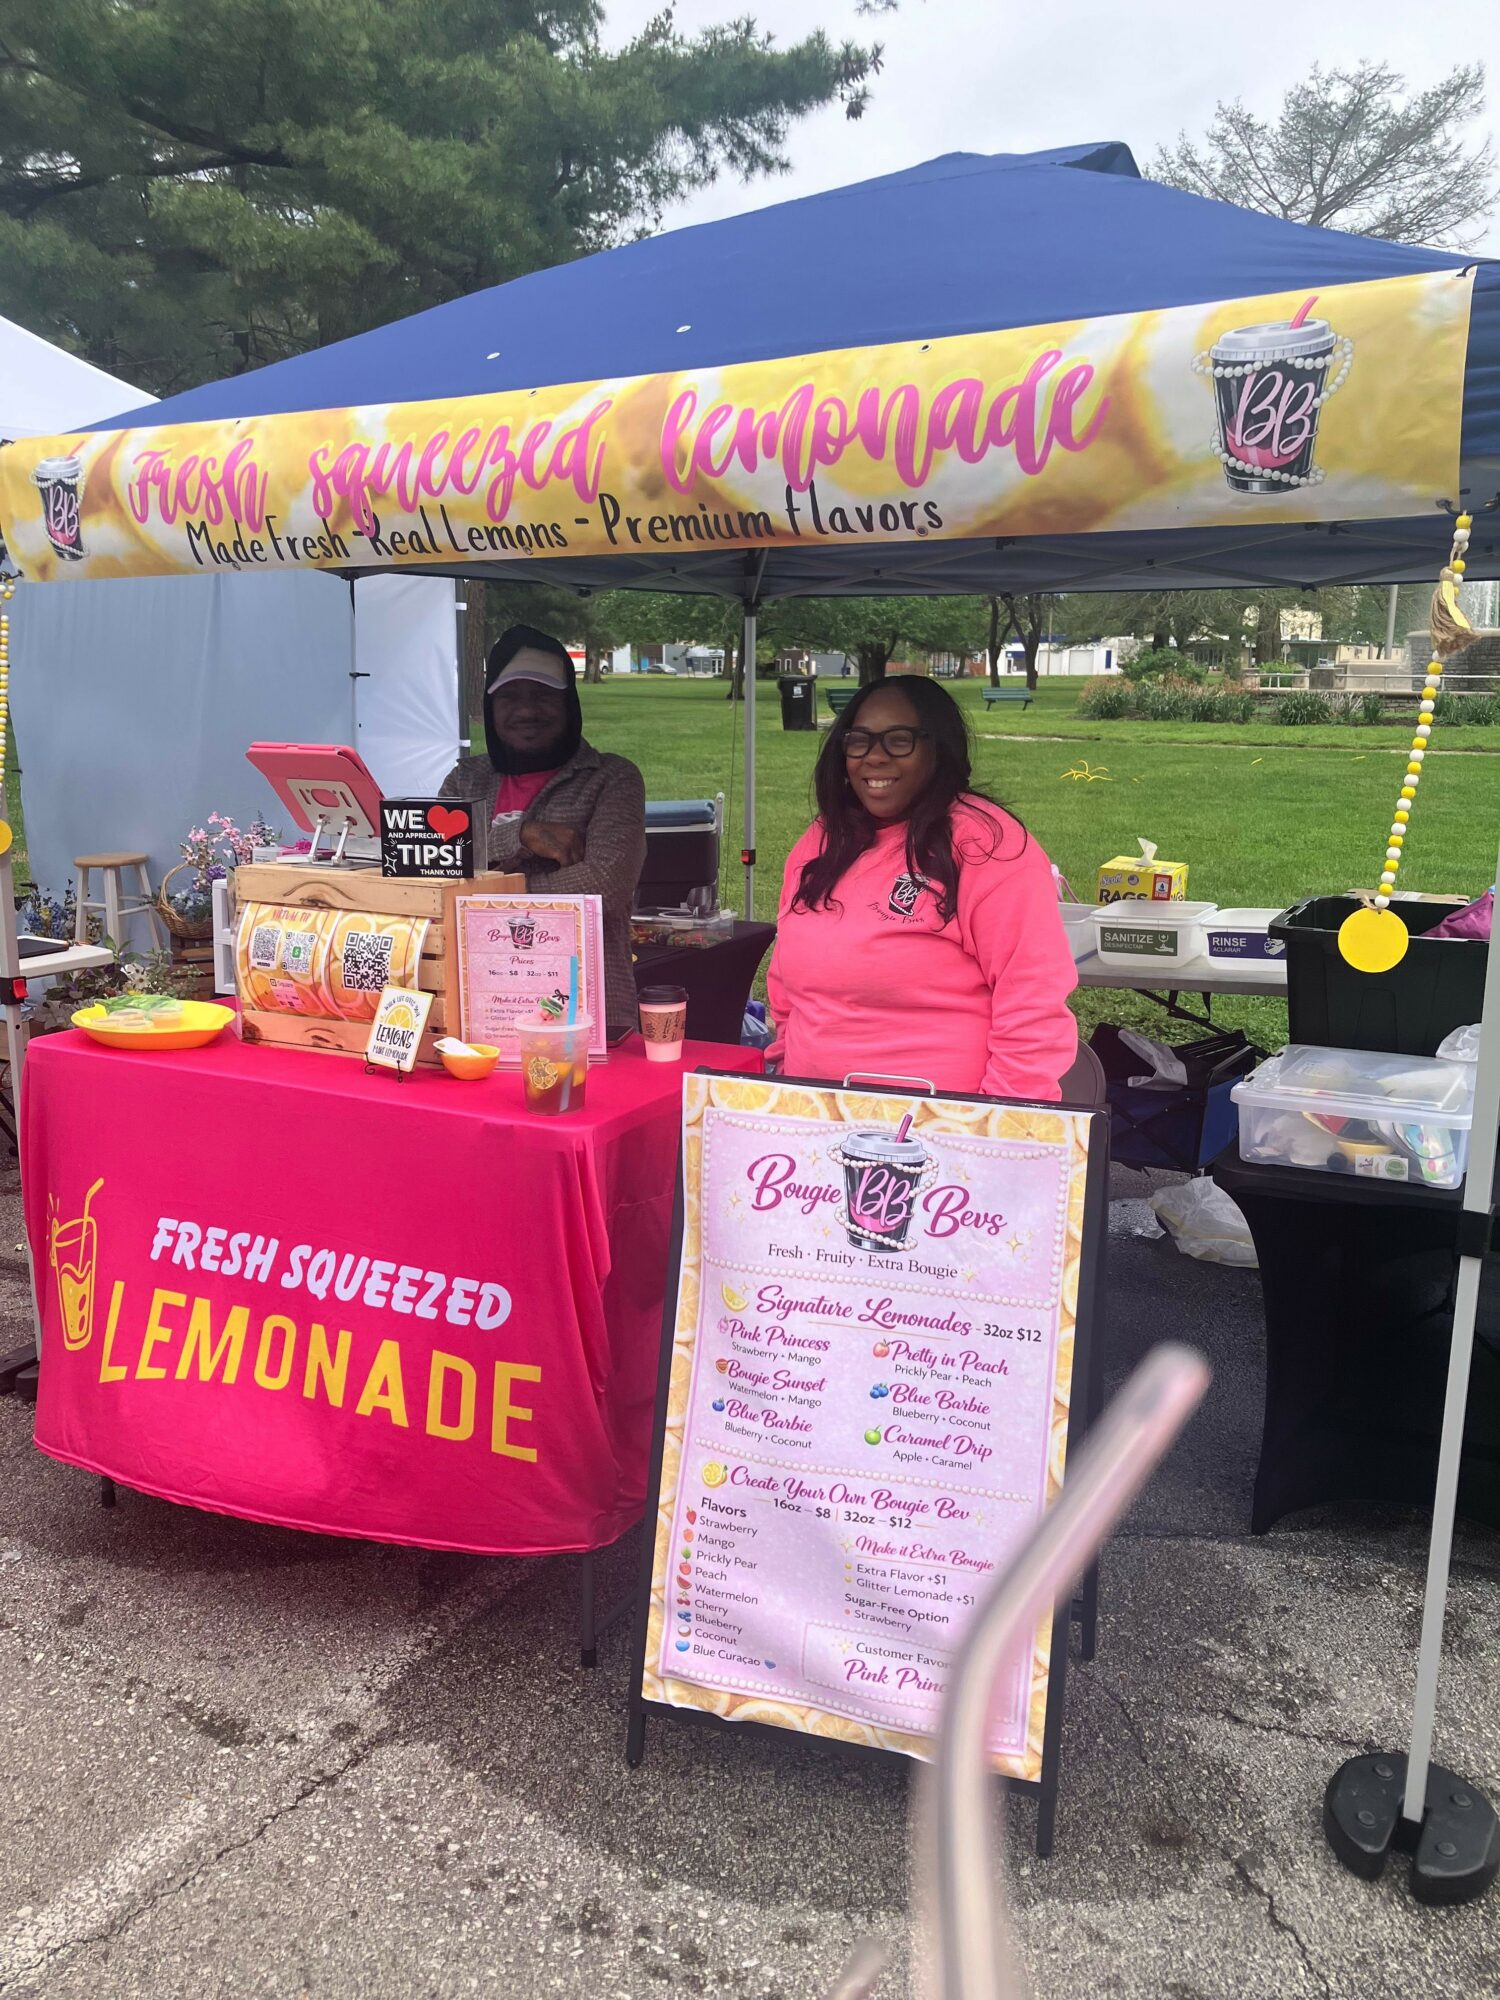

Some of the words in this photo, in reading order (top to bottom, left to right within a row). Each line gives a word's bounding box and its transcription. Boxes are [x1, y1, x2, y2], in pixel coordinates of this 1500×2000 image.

[1235, 371, 1318, 457] BB
[128, 438, 269, 533] Fresh
[309, 400, 613, 537] squeezed
[661, 349, 1110, 494] lemonade
[48, 485, 80, 539] BB
[186, 519, 267, 565] Made
[265, 515, 350, 561] Fresh
[363, 505, 441, 557] Real
[440, 505, 568, 554] Lemons
[599, 493, 775, 545] Premium
[384, 809, 425, 830] WE
[405, 832, 445, 840] APPRECIATE
[397, 844, 463, 867] TIPS!
[896, 882, 918, 905] BB
[1099, 888, 1149, 903] RAGS
[1104, 932, 1153, 944] SANITIZE
[1212, 936, 1247, 947] RINSE
[509, 955, 534, 965] Prices
[376, 1024, 415, 1049] LEMONS
[747, 1153, 842, 1215] Bougie
[855, 1166, 914, 1227] BB
[922, 1185, 1008, 1238] Bevs
[150, 1217, 279, 1283] FRESH
[281, 1244, 512, 1330] SQUEEZED
[768, 1243, 803, 1260] Fresh
[816, 1248, 855, 1268] Fruity
[868, 1254, 904, 1271] Extra
[908, 1256, 958, 1279] Bougie
[757, 1285, 854, 1321] Signature
[857, 1298, 972, 1336] Lemonades
[983, 1323, 1014, 1339] 32oz
[1017, 1327, 1042, 1343] $12
[729, 1319, 762, 1342] Pink
[765, 1326, 831, 1351] Princess
[732, 1341, 778, 1362] Strawberry
[788, 1353, 821, 1367] Mango
[890, 1340, 938, 1369] Pretty
[941, 1352, 956, 1367] in
[959, 1350, 1010, 1376] Peach
[99, 1280, 542, 1463] LEMONADE
[727, 1359, 770, 1387] Bougie
[773, 1370, 827, 1392] Sunset
[895, 1364, 927, 1380] Prickly
[930, 1369, 951, 1381] Pear
[962, 1375, 992, 1388] Peach
[728, 1381, 778, 1402] Watermelon
[788, 1394, 822, 1409] Mango
[889, 1383, 931, 1404] Blue
[935, 1390, 991, 1415] Barbie
[726, 1399, 760, 1422] Blue
[761, 1409, 813, 1433] Barbie
[893, 1407, 939, 1425] Blueberry
[948, 1415, 991, 1431] Coconut
[724, 1421, 763, 1443] Blueberry
[771, 1434, 812, 1449] Coconut
[884, 1425, 951, 1450] Caramel
[953, 1435, 993, 1463] Drip
[892, 1450, 923, 1464] Apple
[932, 1456, 972, 1471] Caramel
[730, 1465, 781, 1492] Create
[783, 1477, 826, 1501] Your
[829, 1483, 868, 1506] Own
[871, 1488, 930, 1518] Bougie
[934, 1497, 971, 1521] Bev
[701, 1496, 748, 1518] Flavors
[773, 1498, 802, 1513] 16oz
[815, 1506, 831, 1519] $8
[843, 1510, 876, 1525] 32oz
[889, 1516, 912, 1530] $12
[699, 1515, 758, 1538] Strawberry
[697, 1533, 736, 1550] Mango
[855, 1536, 897, 1555] Make
[899, 1546, 909, 1556] it
[909, 1543, 946, 1562] Extra
[946, 1550, 995, 1573] Bougie
[696, 1550, 732, 1568] Prickly
[734, 1557, 758, 1570] Pear
[695, 1567, 727, 1582] Peach
[857, 1563, 887, 1578] Extra
[890, 1568, 925, 1583] Flavor
[928, 1574, 947, 1586] +$1
[695, 1583, 759, 1605] Watermelon
[856, 1578, 891, 1594] Glitter
[894, 1585, 953, 1603] Lemonade
[956, 1594, 976, 1606] +$1
[694, 1599, 729, 1617] Cherry
[844, 1593, 905, 1616] Sugar-Free
[908, 1608, 950, 1624] Option
[854, 1609, 912, 1633] Strawberry
[694, 1628, 738, 1646] Coconut
[695, 1614, 743, 1635] Blueberry
[693, 1644, 716, 1658] Blue
[718, 1649, 761, 1667] Curaçao
[856, 1642, 914, 1662] Customer
[917, 1653, 952, 1670] Favor
[844, 1658, 890, 1685] Pink
[896, 1667, 947, 1693] Princ
